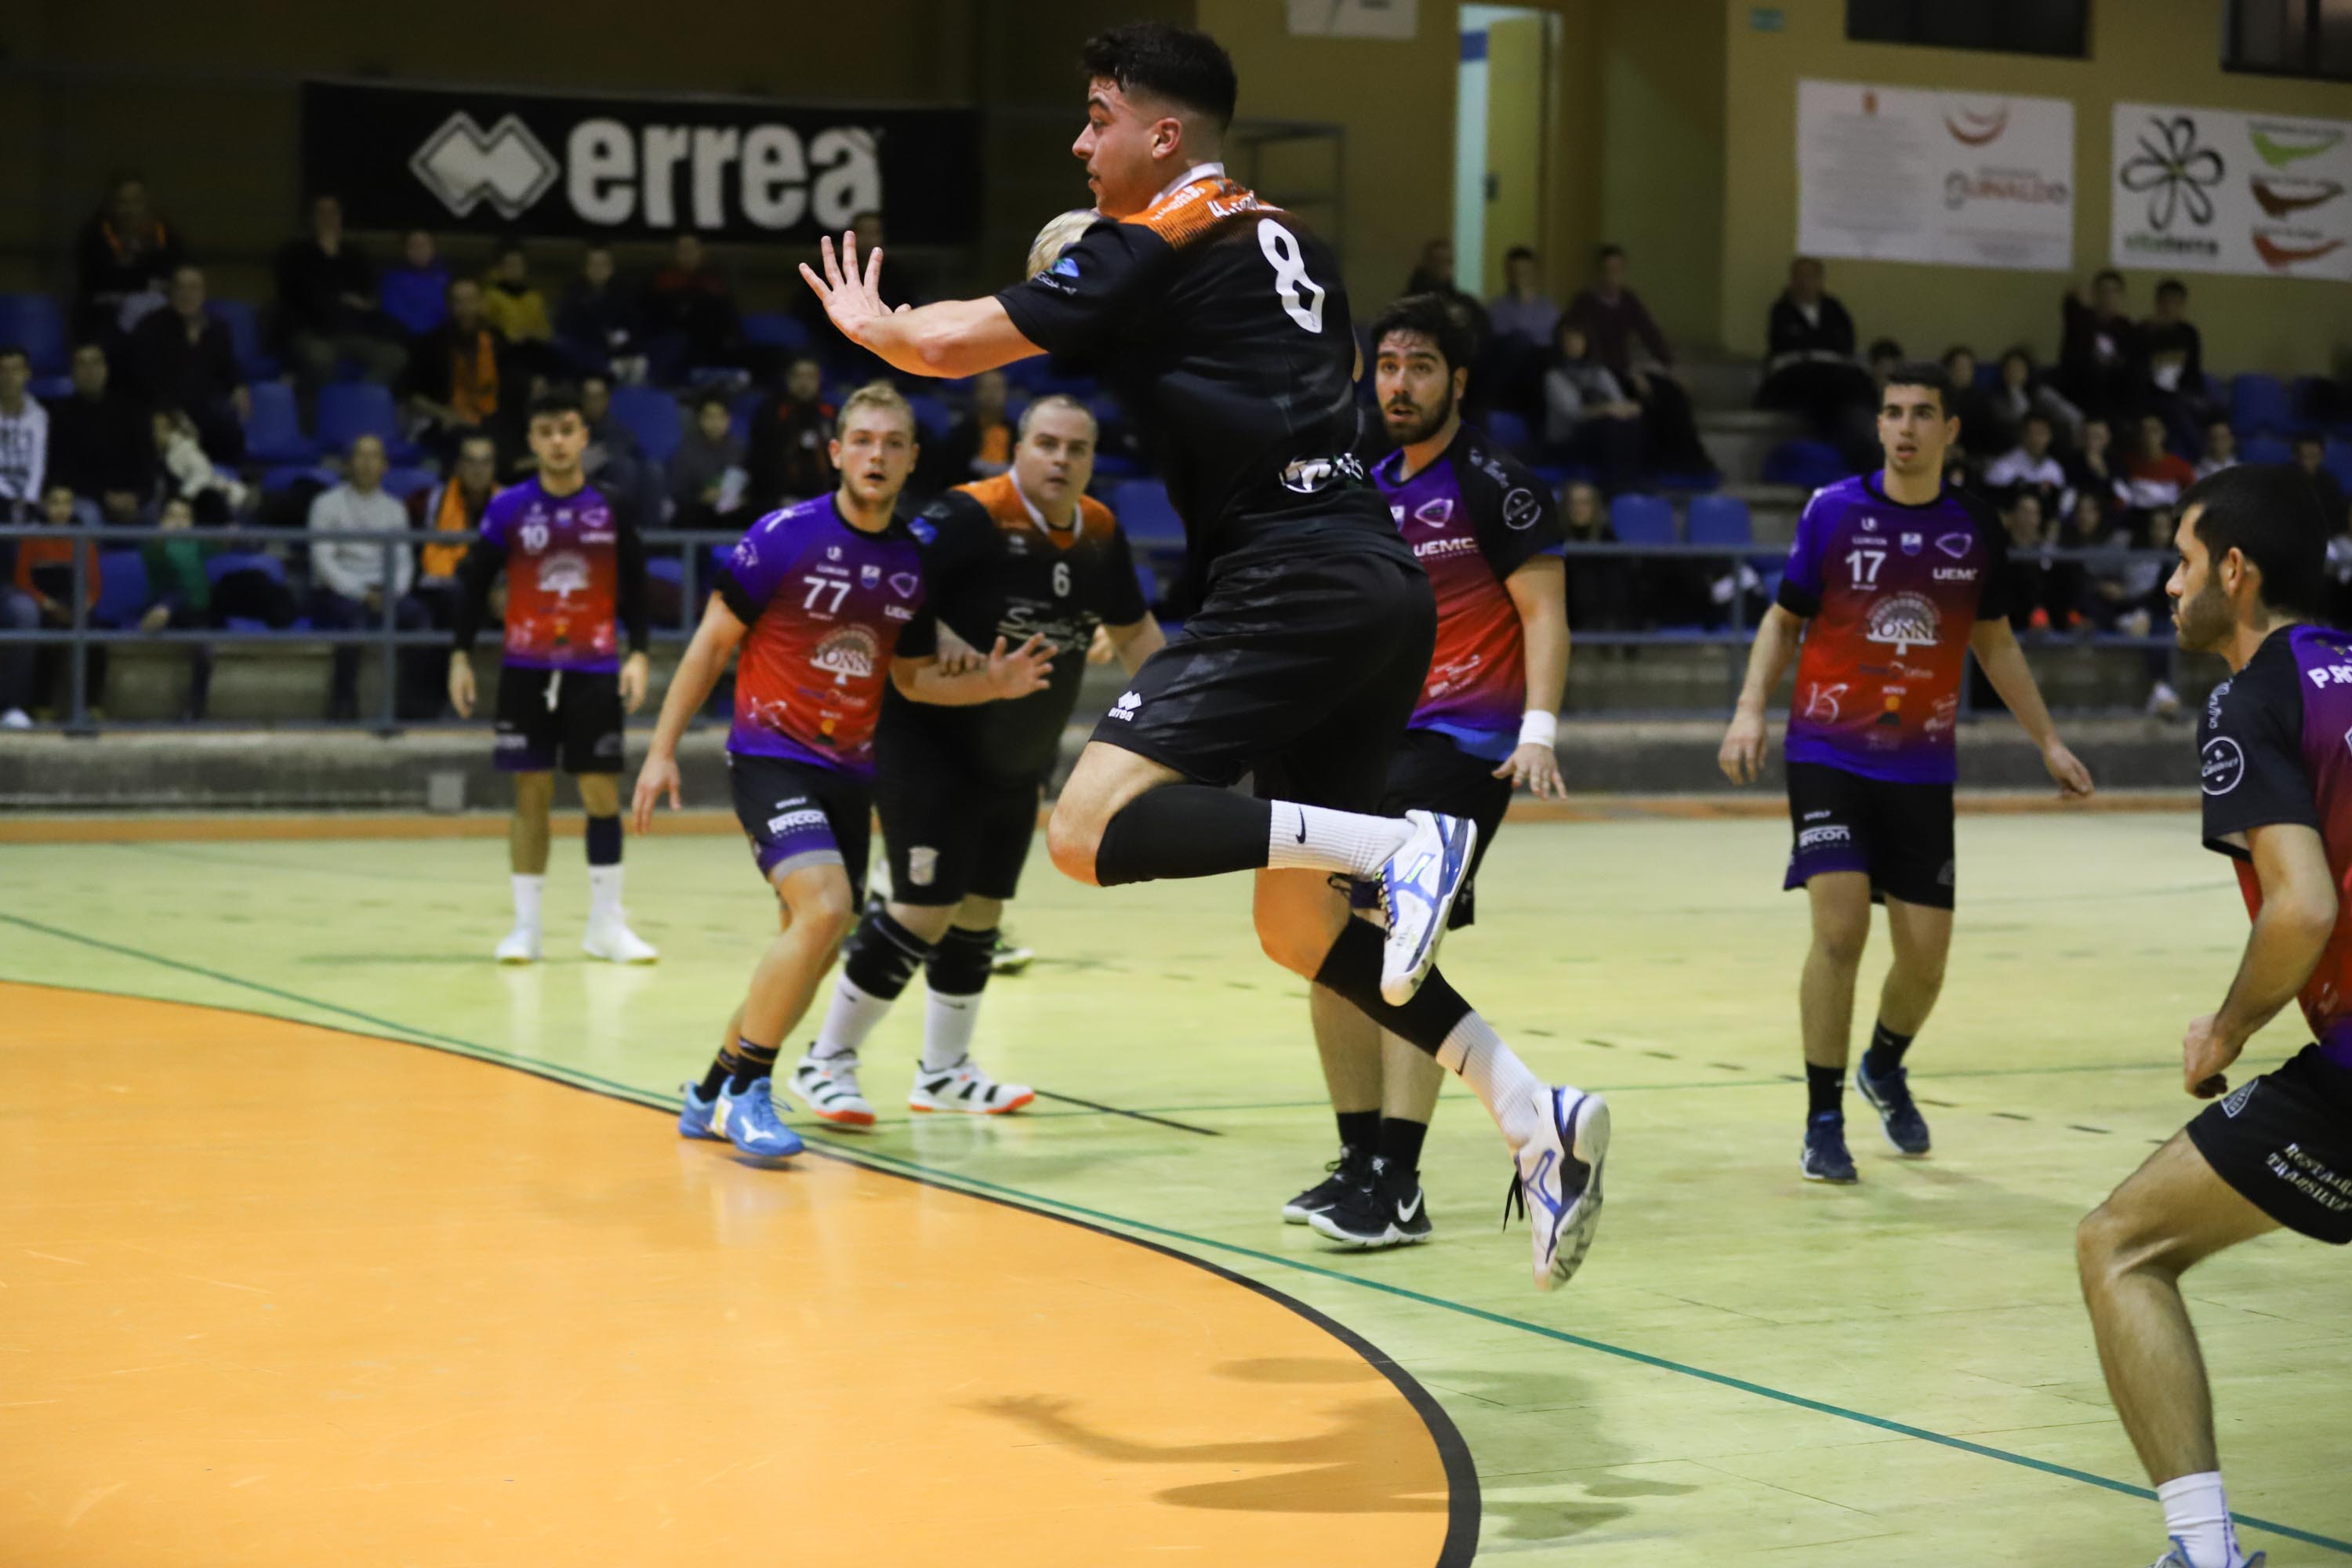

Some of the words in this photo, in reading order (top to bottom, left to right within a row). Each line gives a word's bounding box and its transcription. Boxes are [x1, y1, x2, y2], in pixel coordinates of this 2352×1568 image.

[567, 118, 883, 230] errea
[1257, 217, 1327, 334] 8
[520, 524, 550, 552] 10
[1413, 536, 1478, 557] UEMC
[1052, 561, 1072, 598] 6
[1846, 550, 1887, 583] 17
[802, 575, 853, 614] 77
